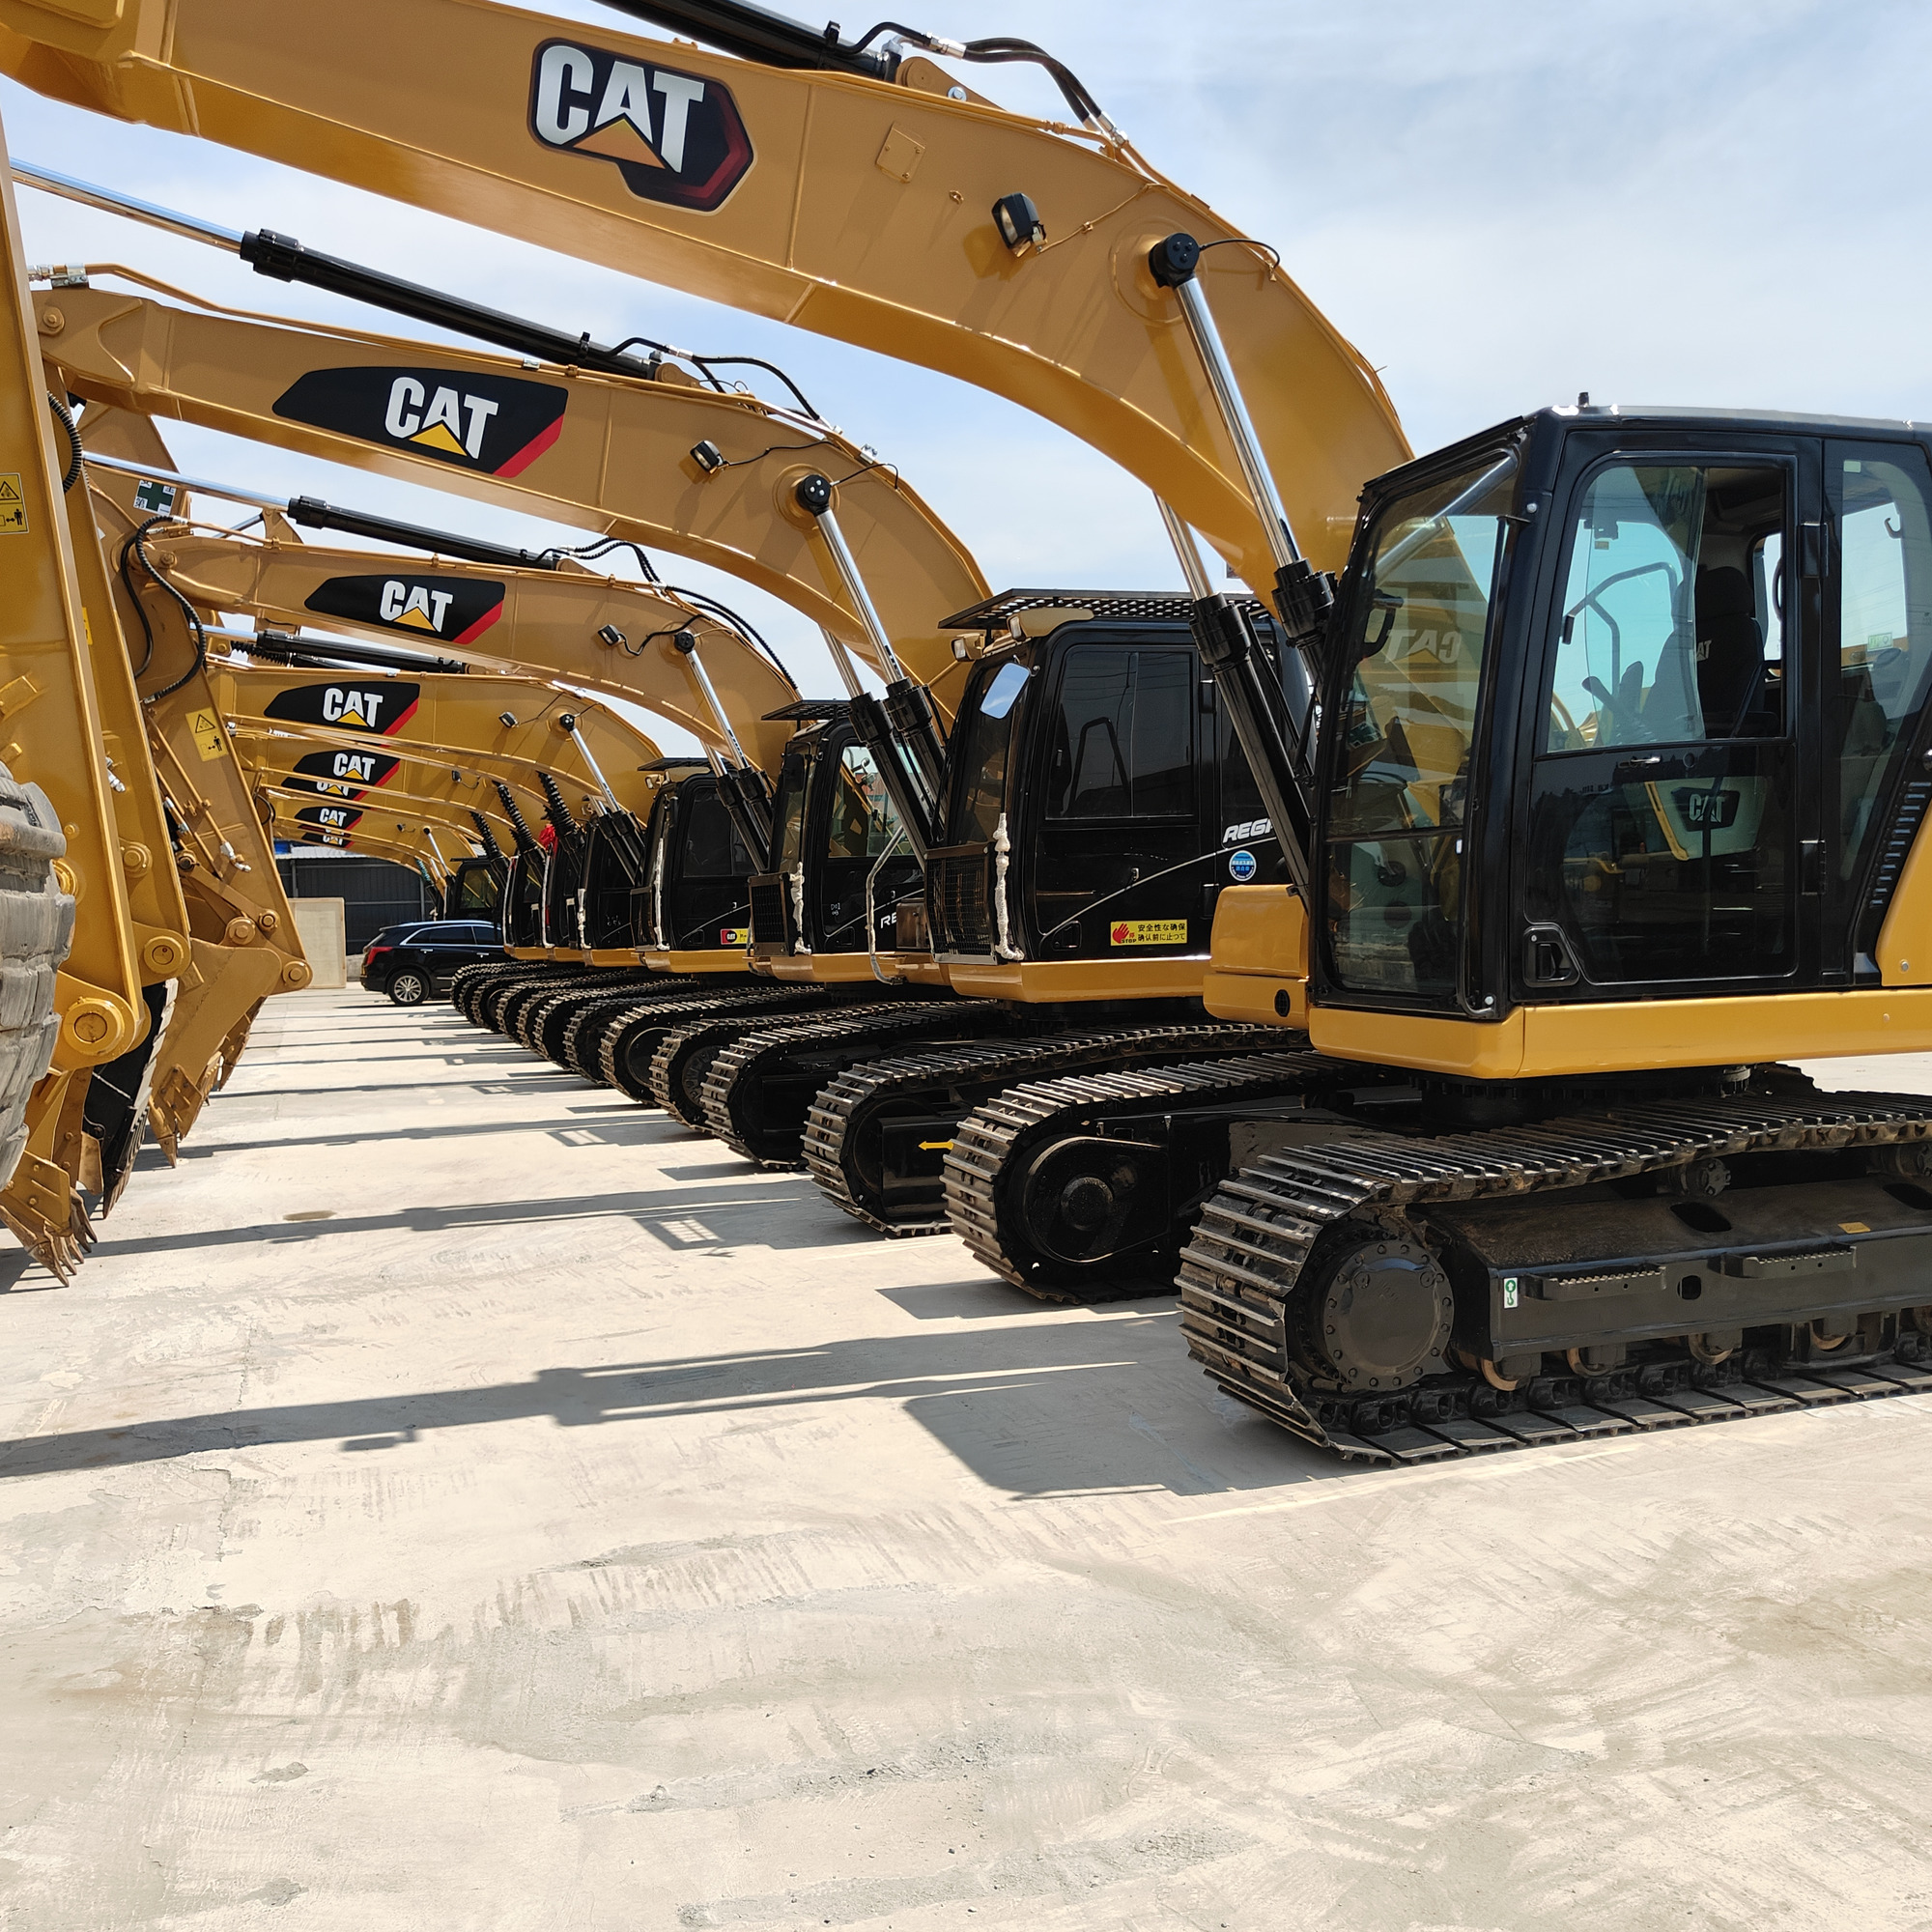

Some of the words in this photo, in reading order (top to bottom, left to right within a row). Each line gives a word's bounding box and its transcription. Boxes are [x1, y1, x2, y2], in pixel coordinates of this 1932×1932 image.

[536, 45, 705, 174] CAT
[384, 377, 499, 460] CAT
[380, 580, 454, 633] CAT
[1696, 639, 1713, 659] AT
[322, 687, 384, 728] CAT
[332, 753, 376, 781] CAT
[319, 808, 348, 827] CAT
